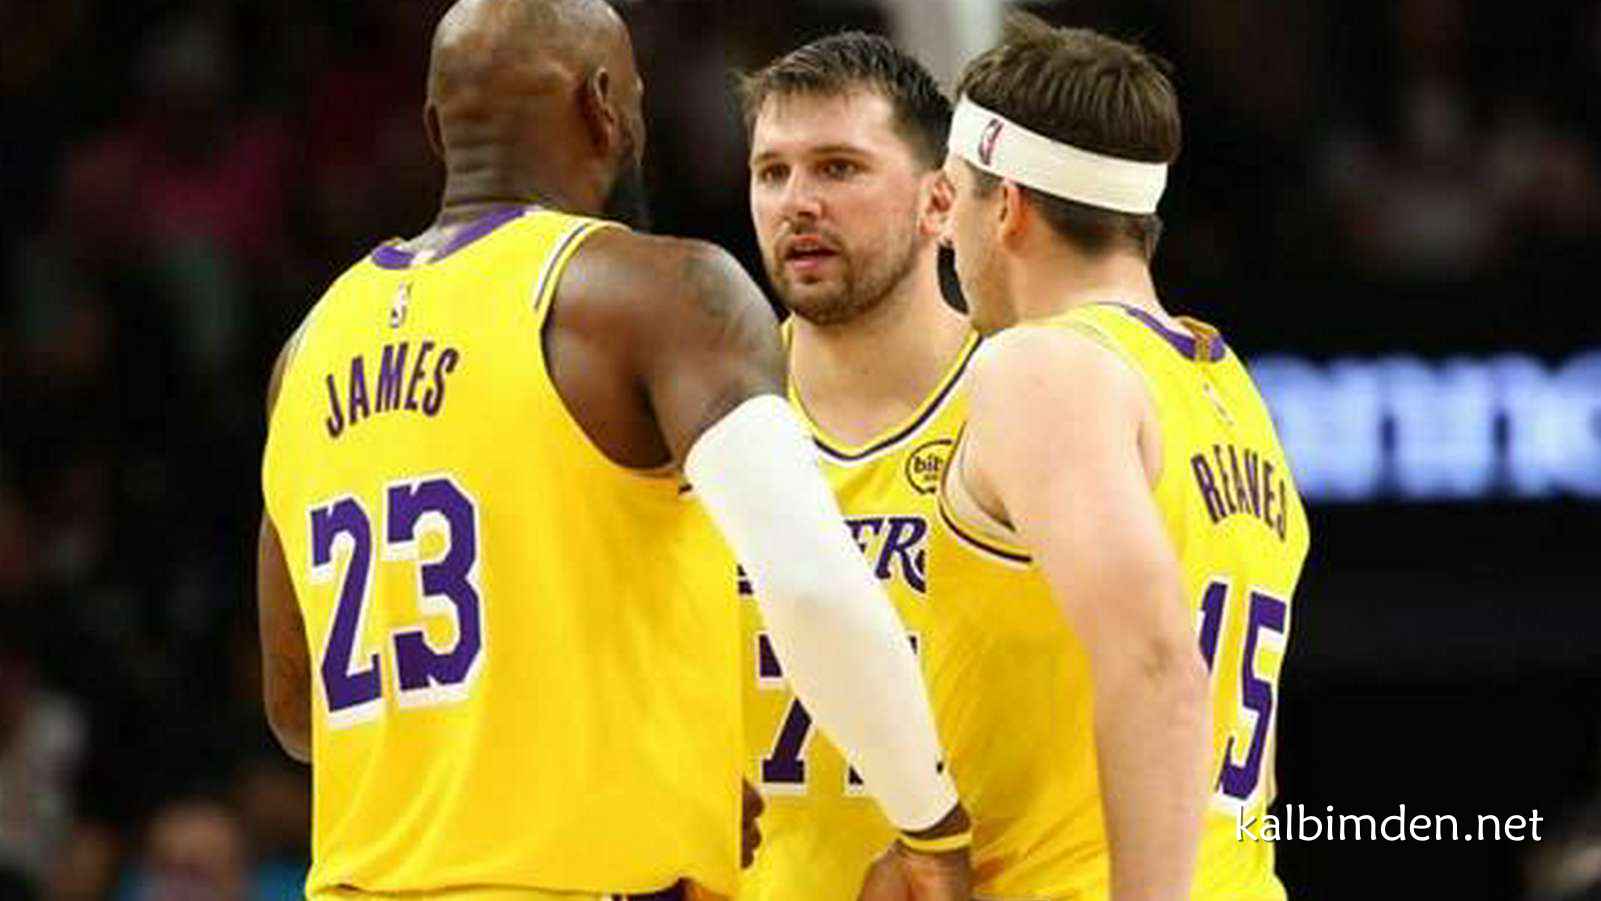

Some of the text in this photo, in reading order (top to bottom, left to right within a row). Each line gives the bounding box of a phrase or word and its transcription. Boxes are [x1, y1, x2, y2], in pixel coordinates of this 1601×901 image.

[325, 341, 459, 438] JAMES
[310, 478, 481, 712] 23
[1200, 582, 1287, 799] 15
